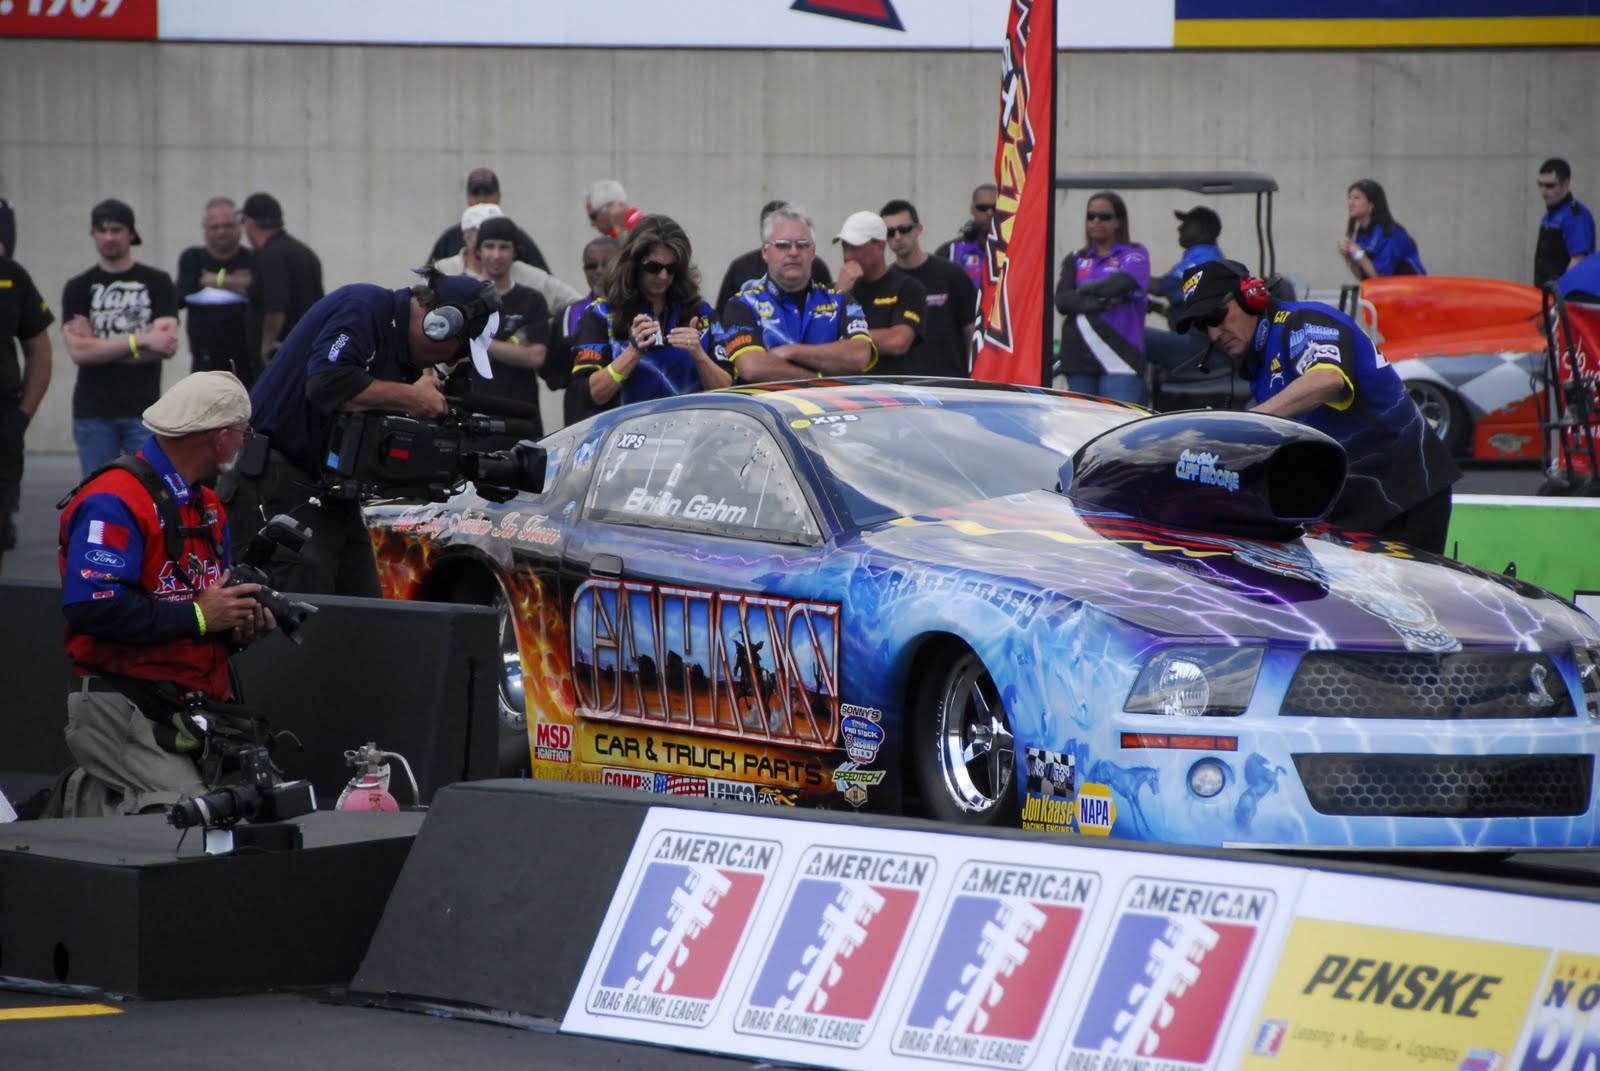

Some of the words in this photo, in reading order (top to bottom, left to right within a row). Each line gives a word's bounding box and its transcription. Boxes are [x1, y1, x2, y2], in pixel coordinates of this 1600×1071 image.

[90, 281, 151, 309] Vans
[810, 414, 859, 425] XPS
[829, 422, 848, 437] 3
[617, 433, 646, 449] XPS
[1200, 465, 1240, 493] MOORE
[623, 487, 682, 516] Brian
[683, 494, 748, 524] Gahm
[517, 513, 561, 545] Town
[92, 551, 118, 566] Ford
[841, 704, 881, 720] SONNY'S
[536, 723, 571, 749] MSD
[857, 728, 879, 739] STOCK
[536, 748, 570, 762] IGNITION
[595, 733, 640, 759] CAR
[645, 736, 659, 763] &
[661, 741, 737, 773] TRUCK
[743, 753, 822, 785] PARTS
[604, 772, 642, 790] COMP
[710, 782, 755, 804] LENCO
[1021, 792, 1041, 822] Jon
[1040, 794, 1074, 826] Kaase
[1080, 797, 1109, 827] NAPA
[1022, 821, 1045, 832] RACING
[1046, 824, 1075, 833] ENGINES
[654, 835, 775, 871] AMERICAN
[804, 851, 930, 887] AMERICAN
[962, 867, 1094, 903] AMERICAN
[1127, 882, 1268, 922] AMERICAN
[1302, 954, 1503, 1019] PENSKE
[592, 989, 622, 1012] DRAG
[623, 993, 665, 1018] RACING
[665, 999, 711, 1023] LEAGUE
[740, 1008, 772, 1032] DRAG
[773, 1012, 817, 1038] RACING
[817, 1019, 867, 1044] LEAGUE
[899, 1029, 931, 1053] DRAG
[932, 1034, 980, 1060] RACING
[979, 1039, 1030, 1066] LEAGUE
